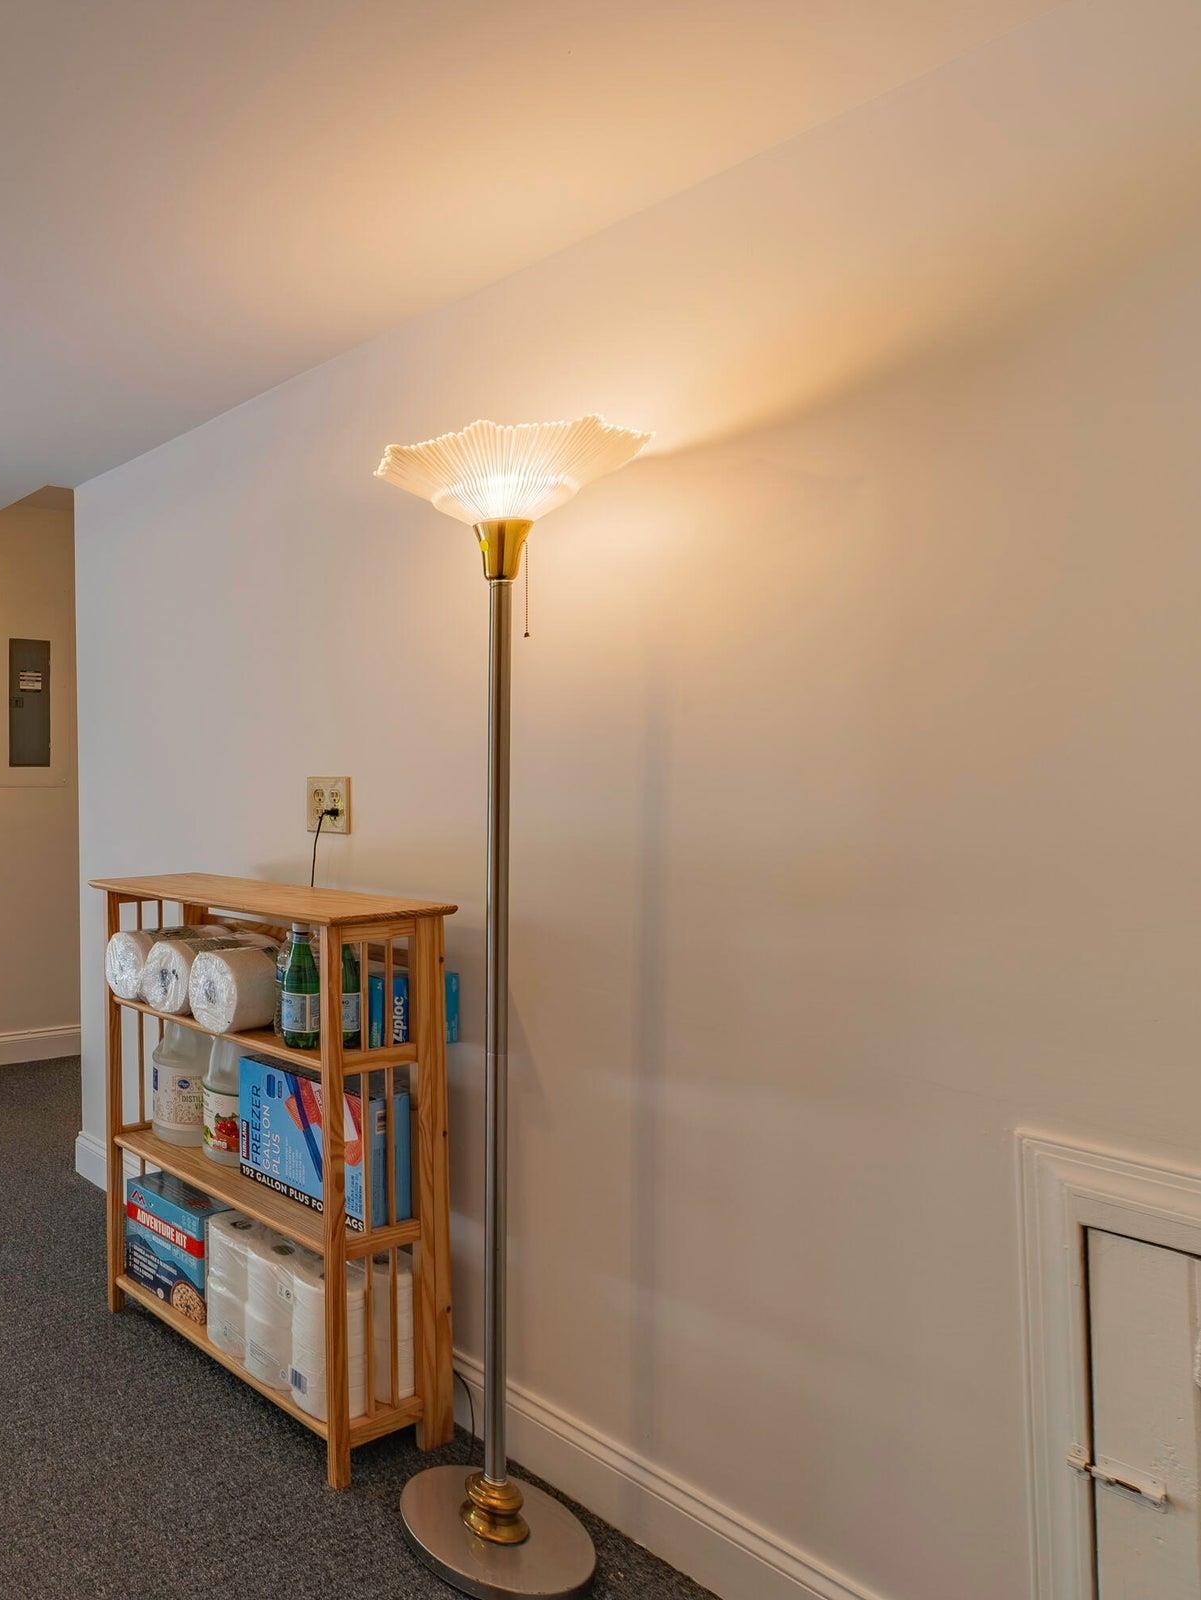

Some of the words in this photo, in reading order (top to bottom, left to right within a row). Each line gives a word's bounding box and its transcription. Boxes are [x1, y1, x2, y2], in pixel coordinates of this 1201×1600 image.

[392, 996, 407, 1042] Ziploc
[252, 1085, 261, 1166] FREEZER
[262, 1105, 270, 1170] GALLON
[272, 1133, 280, 1175] PLUS
[242, 1165, 254, 1178] 192
[255, 1172, 288, 1194] GALLON
[289, 1188, 310, 1206] PLUS
[311, 1201, 323, 1212] FO
[345, 1216, 364, 1231] AGS
[136, 1208, 175, 1242] ADVENTURE
[175, 1230, 187, 1249] KIT
